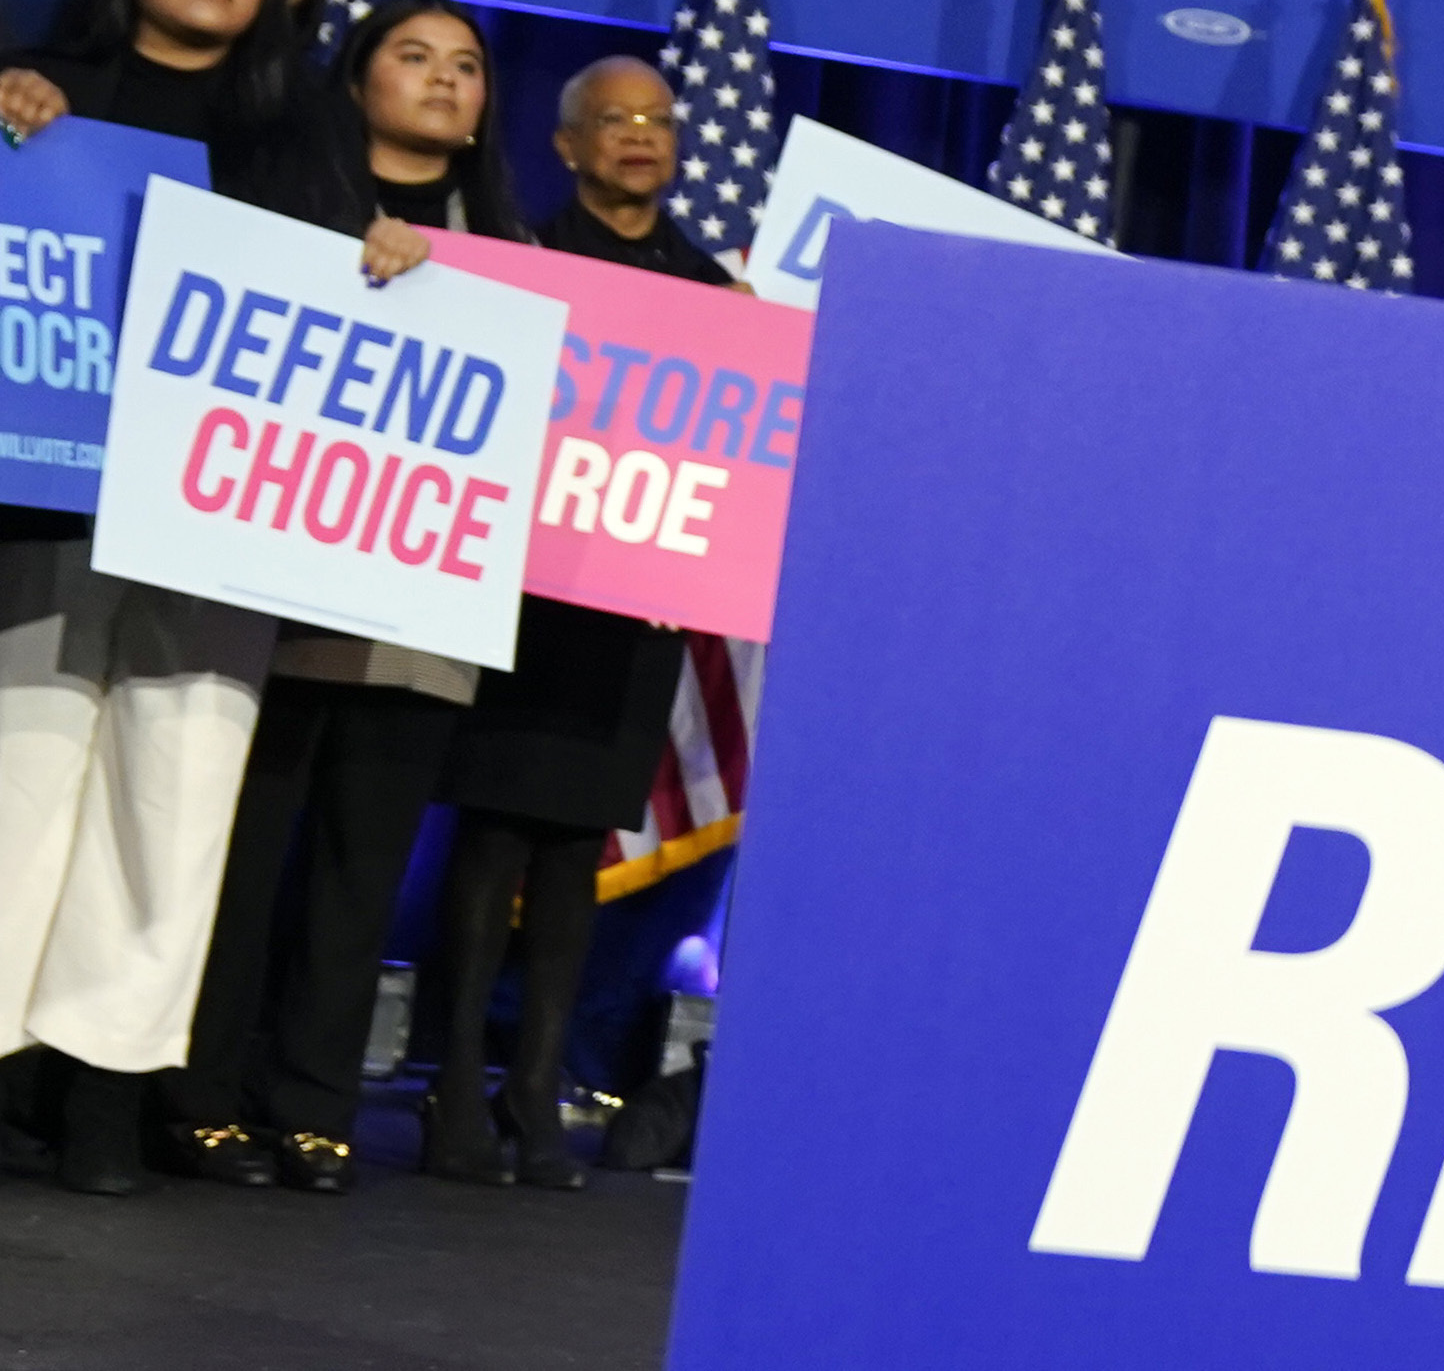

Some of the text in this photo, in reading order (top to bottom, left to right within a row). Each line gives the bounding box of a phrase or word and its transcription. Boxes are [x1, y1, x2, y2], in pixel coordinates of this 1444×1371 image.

[147, 270, 507, 457] DEFEND
[182, 407, 510, 582] CHOICE
[539, 436, 730, 556] ROE
